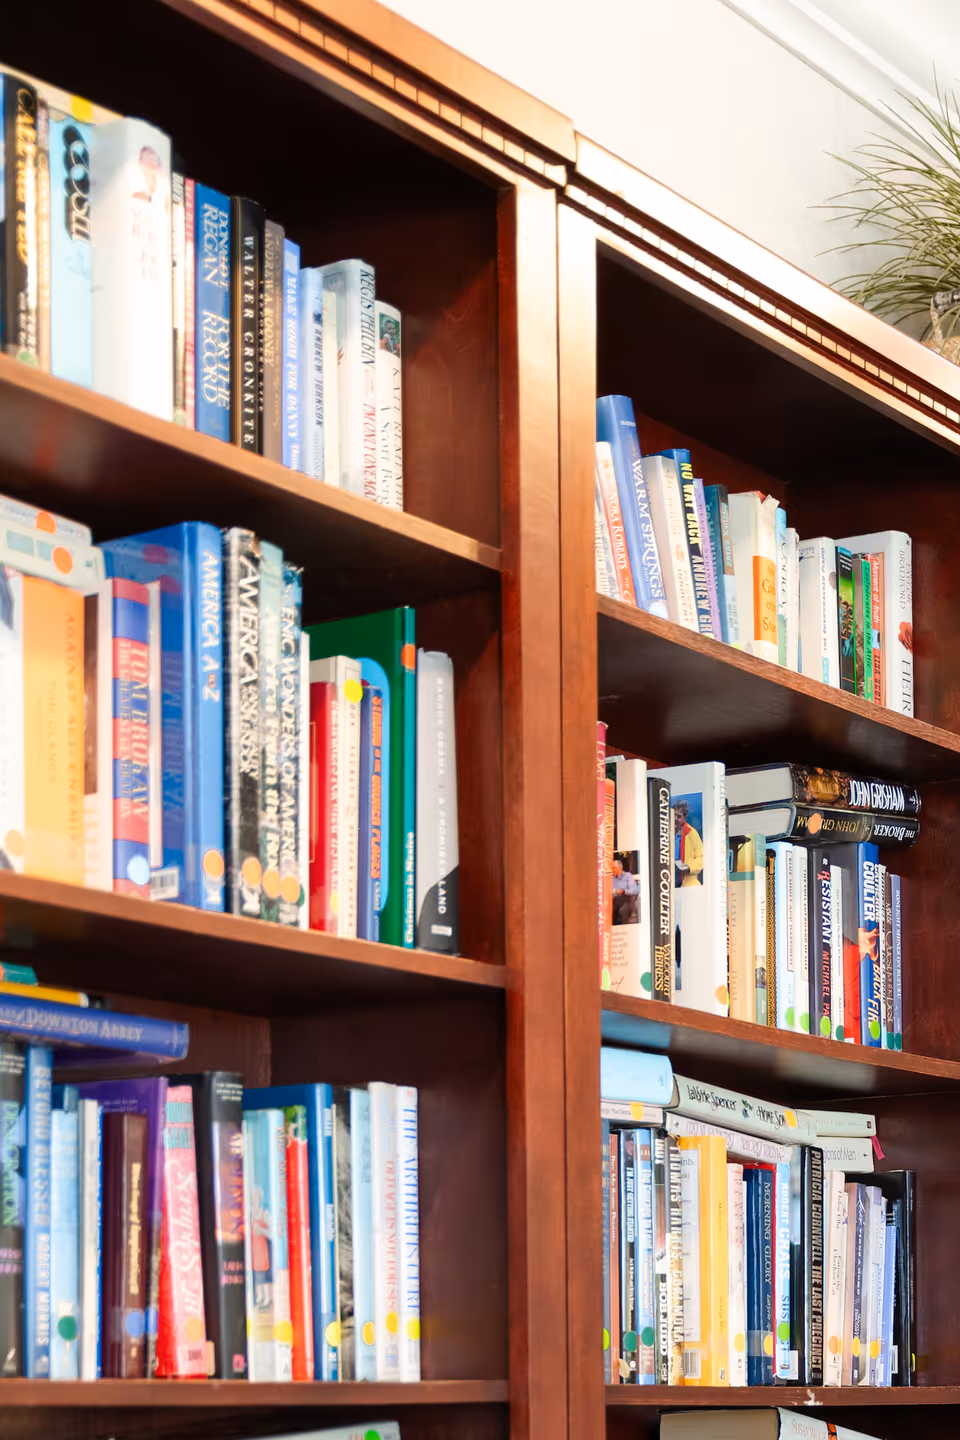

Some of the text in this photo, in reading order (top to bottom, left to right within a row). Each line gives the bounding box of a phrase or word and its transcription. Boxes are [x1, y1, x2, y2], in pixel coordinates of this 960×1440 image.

[201, 203, 221, 289] REGAN
[242, 235, 257, 445] WALTER CRONKITE
[360, 269, 376, 371] REGIS PHILBIN
[202, 311, 221, 404] RECORD
[213, 315, 231, 411] FOR THE
[680, 462, 694, 480] NO
[682, 484, 698, 515] WAY
[608, 493, 628, 570] NORA ROBERTS
[631, 459, 664, 599] WARM SPRINGS
[686, 514, 702, 545] BACK
[691, 555, 712, 612] ANDREW
[872, 560, 881, 592] Moment
[873, 593, 880, 603] of
[898, 549, 907, 610] BRADFORD
[873, 604, 881, 623] Truth
[900, 660, 913, 713] HEIR
[130, 648, 149, 820] TOM BROKAW
[848, 779, 906, 812] JOHN GRISHAM
[659, 787, 671, 936] CATHERINE COULTER
[862, 860, 876, 922] COULTER
[817, 870, 832, 998] RESISTANT MICHAEL
[654, 945, 664, 992] HEIRESS
[662, 943, 673, 1000] VALCOURT
[872, 963, 882, 1001] BACK
[33, 1065, 51, 1346] BEYOND BLESSED ROBERT MORRIS
[625, 1167, 635, 1243] I'M JUST GETTING STARTED
[811, 1149, 823, 1370] PATRICIA CORNWELL THE LAST PRECINCT
[659, 1281, 669, 1356] BOB JUDD
